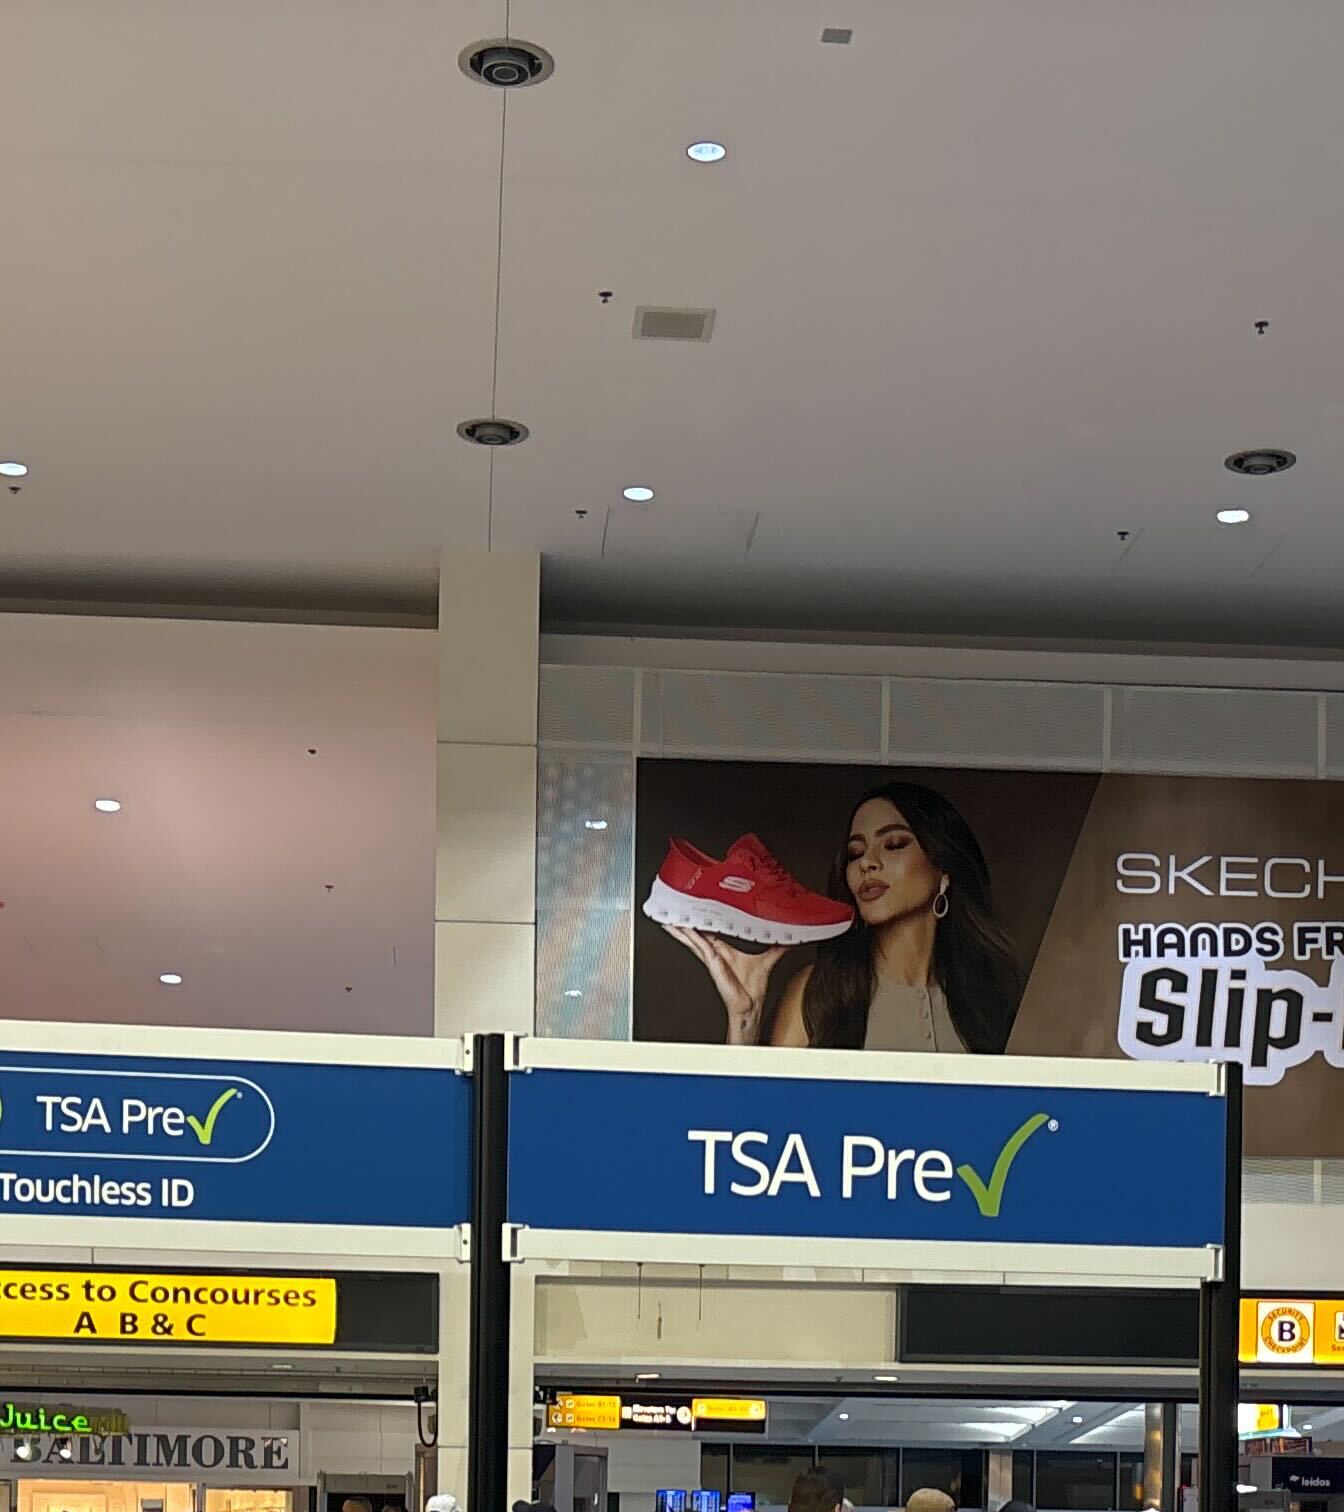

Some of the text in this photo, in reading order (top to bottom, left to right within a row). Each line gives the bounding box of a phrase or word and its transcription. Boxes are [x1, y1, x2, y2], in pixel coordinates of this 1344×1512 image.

[1121, 922, 1282, 960] HANDS
[36, 1096, 184, 1136] TSA Pre
[687, 1130, 954, 1202] TSA Pre
[161, 1179, 194, 1207] ID
[81, 1280, 117, 1302] to
[129, 1280, 317, 1307] Concourses
[73, 1311, 206, 1337] A B & C
[1268, 1307, 1305, 1322] SECURITY
[1278, 1320, 1296, 1342] B
[1263, 1336, 1307, 1354] CHECKPOINT
[0, 1404, 92, 1432] Juice
[9, 1434, 289, 1469] BALTIMORE
[1301, 1476, 1331, 1487] leidos
